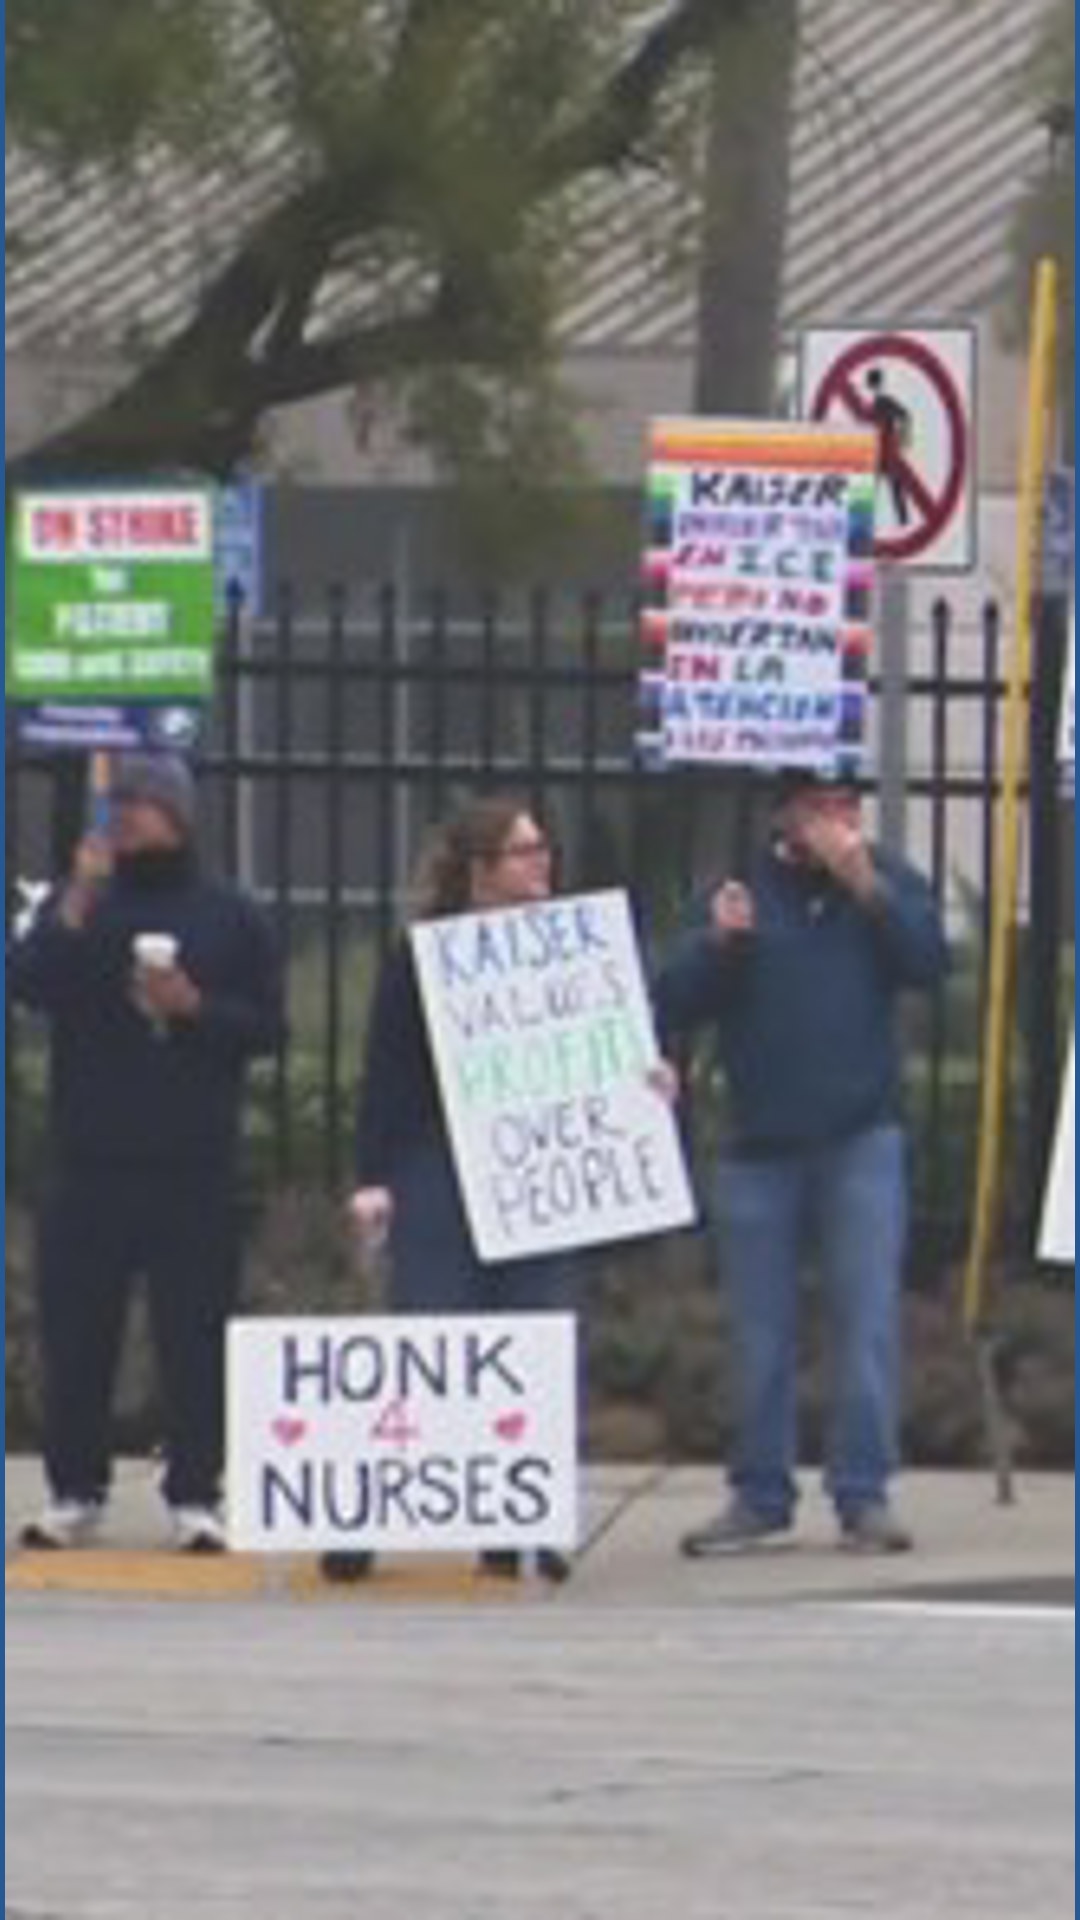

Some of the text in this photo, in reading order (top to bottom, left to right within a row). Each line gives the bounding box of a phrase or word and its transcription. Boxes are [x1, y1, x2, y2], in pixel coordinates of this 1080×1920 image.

[692, 472, 848, 506] KAISER
[88, 507, 199, 547] STRIKE
[433, 902, 610, 988] KAISER
[491, 1093, 628, 1170] OVER
[492, 1134, 662, 1240] PEOPLE
[282, 1334, 526, 1404] HONK
[369, 1396, 420, 1450] 4
[262, 1455, 553, 1532] NURSES
